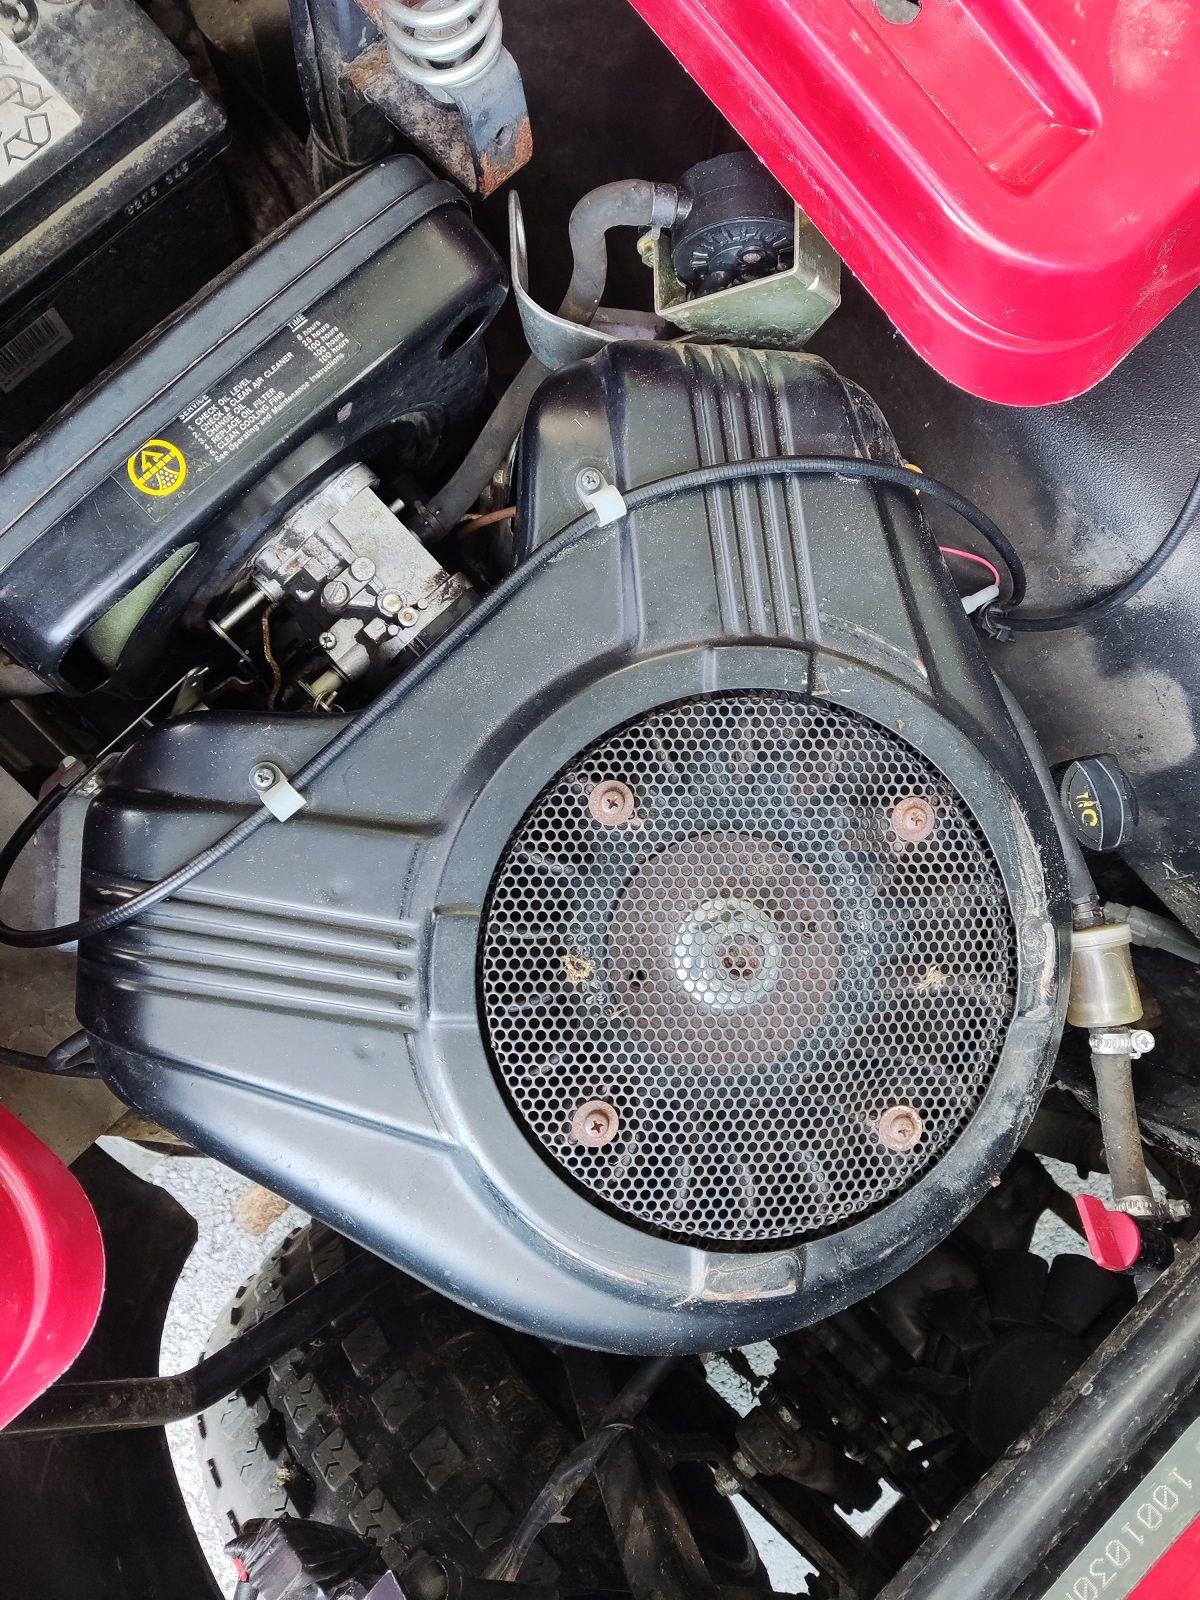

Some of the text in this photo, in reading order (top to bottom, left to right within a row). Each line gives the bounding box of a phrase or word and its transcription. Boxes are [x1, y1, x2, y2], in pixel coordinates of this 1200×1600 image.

[301, 320, 320, 336] hours
[307, 325, 338, 351] 100 hours
[310, 322, 330, 339] hours
[312, 331, 344, 357] 100 hours
[318, 337, 349, 363] 100 hours
[194, 403, 218, 425] CHECK
[217, 395, 231, 405] OIL
[229, 377, 251, 396] LEVEL
[200, 409, 224, 431] CHECK
[229, 386, 252, 406] CLEAN
[251, 376, 264, 388] AIR
[263, 351, 294, 377] CLEANER
[214, 352, 344, 462] See Operating and Maintenance Instructions
[205, 411, 234, 437] CHANGE
[233, 403, 246, 414] OIL
[208, 390, 285, 456] 5. CLEAN COOLING FINS
[210, 416, 241, 443] REPLACE
[240, 407, 254, 418] OIL
[252, 387, 276, 408] FILTER
[1065, 1467, 1192, 1600] 1001030
